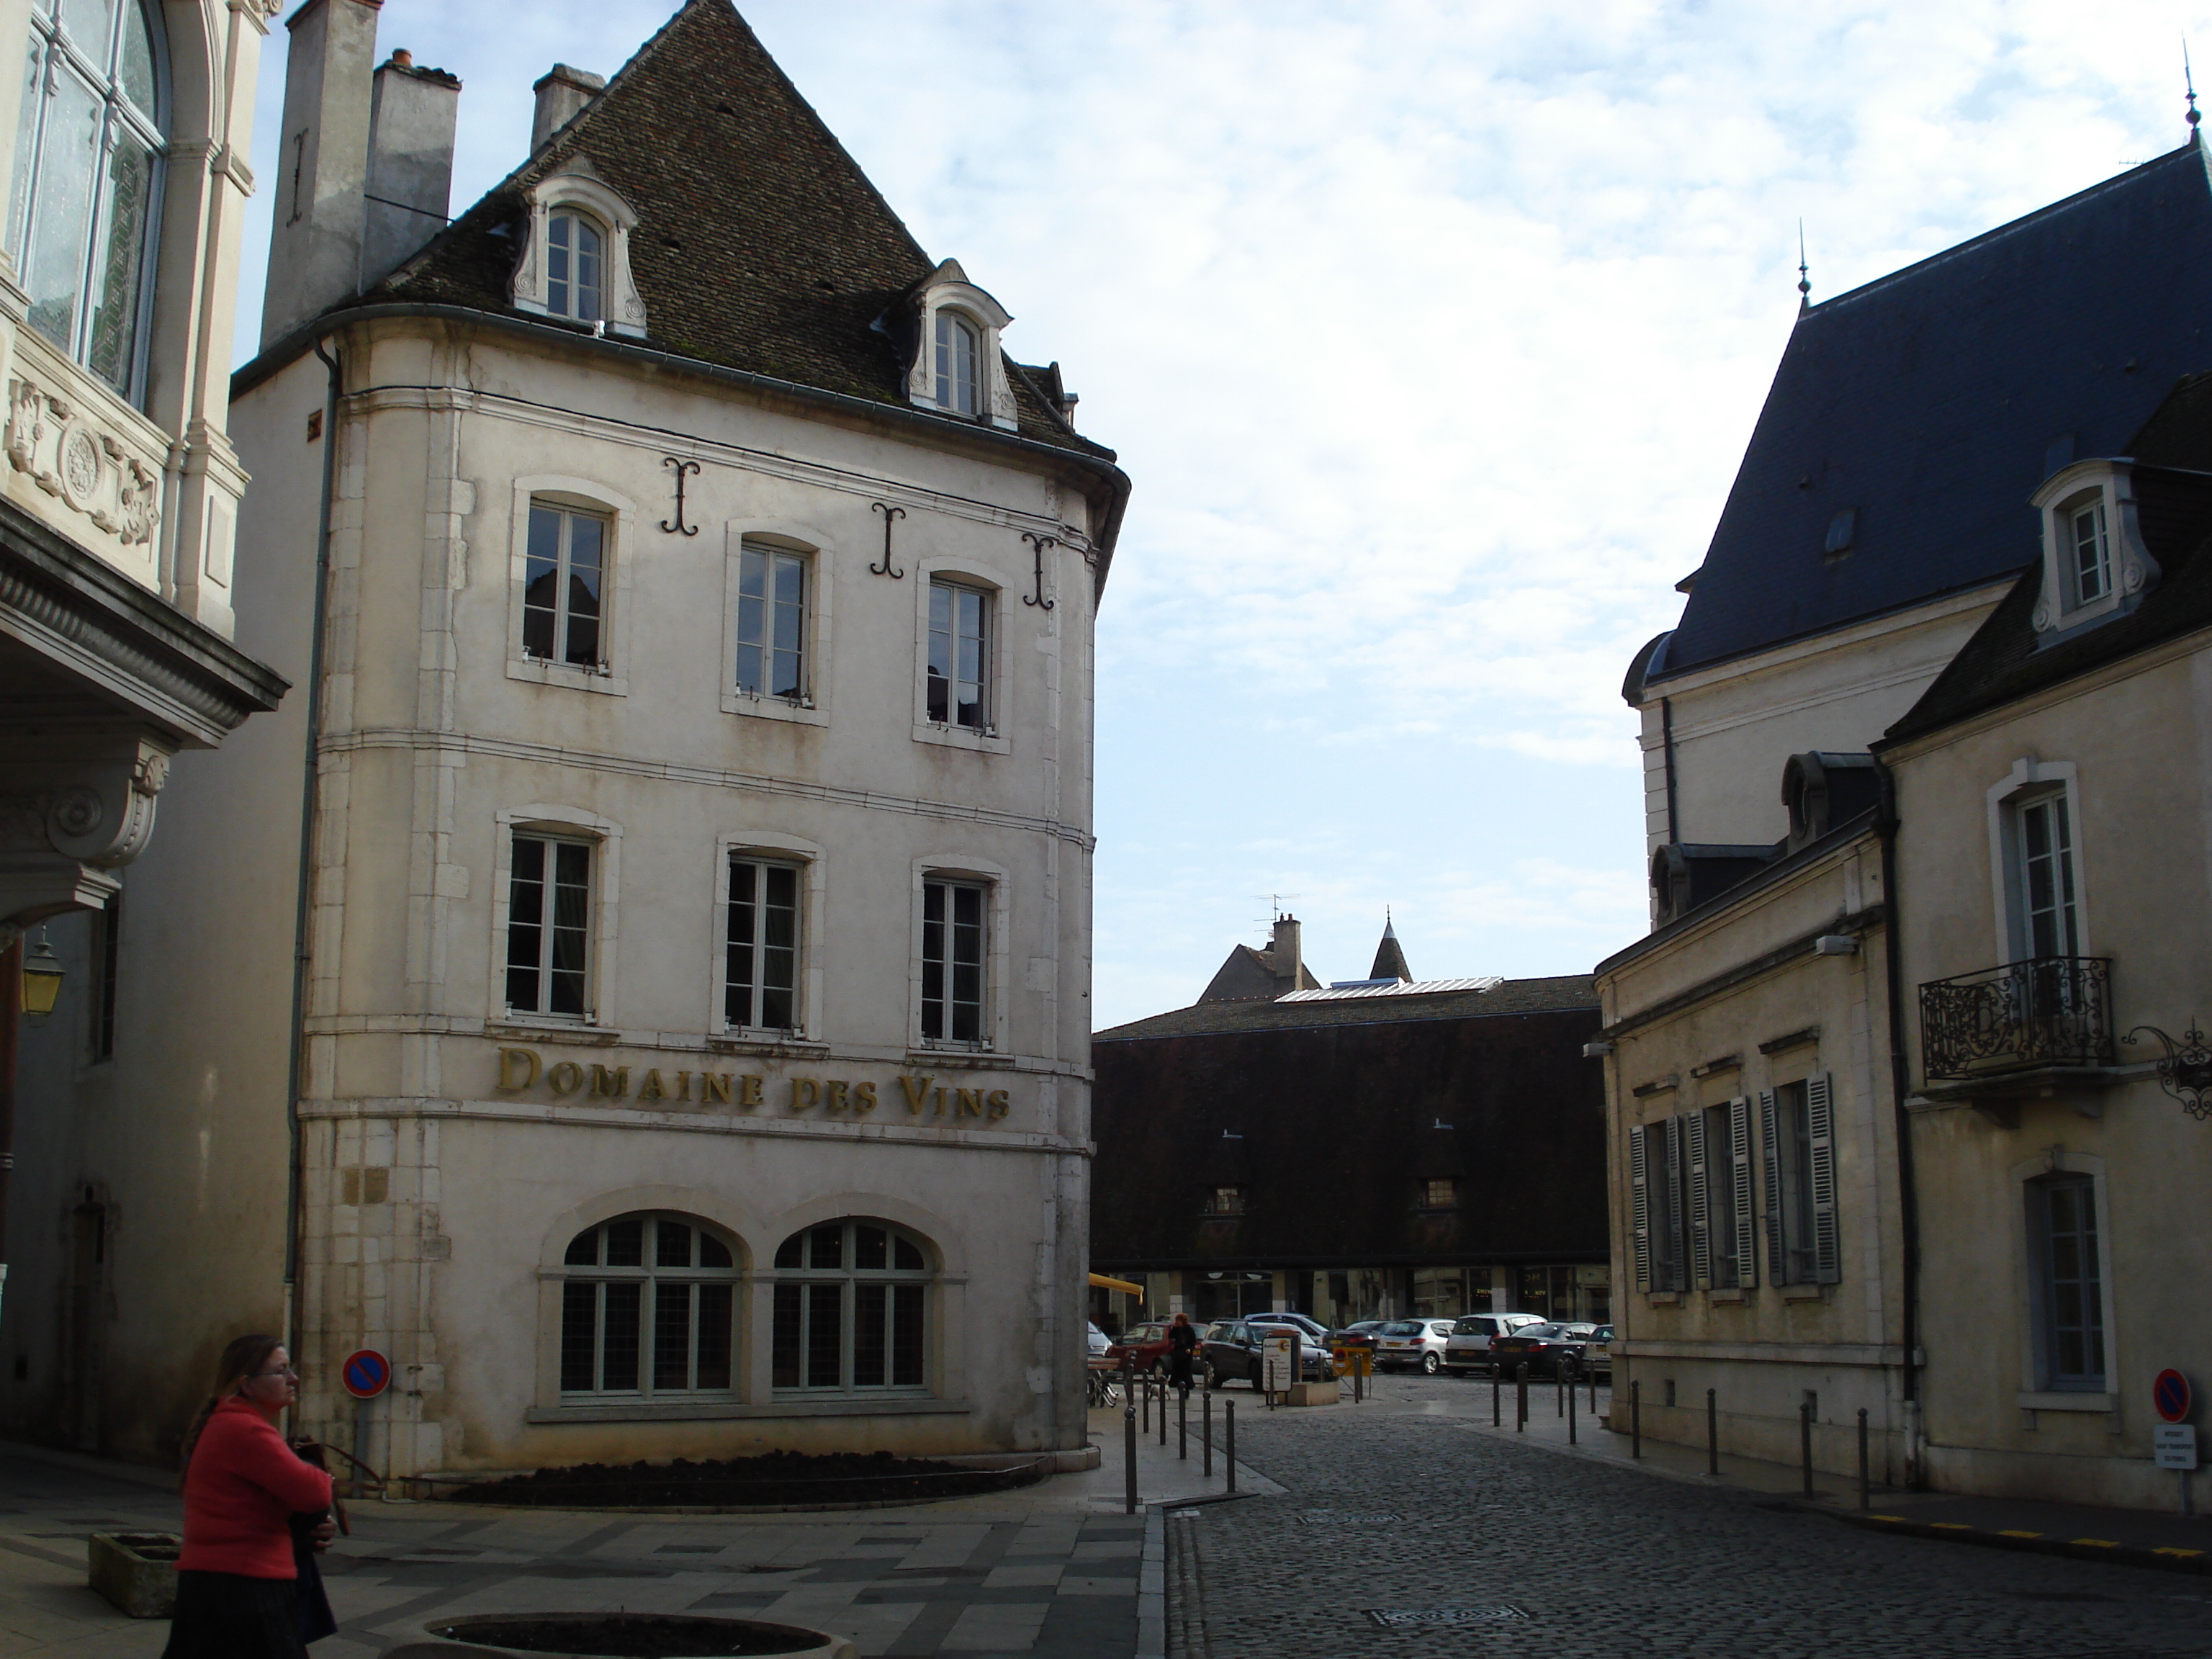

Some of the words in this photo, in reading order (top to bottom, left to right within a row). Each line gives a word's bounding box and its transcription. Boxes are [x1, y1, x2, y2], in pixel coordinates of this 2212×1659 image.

[495, 1046, 764, 1105] DOMAINE
[791, 1077, 877, 1112] DES
[899, 1075, 1010, 1118] VINS
